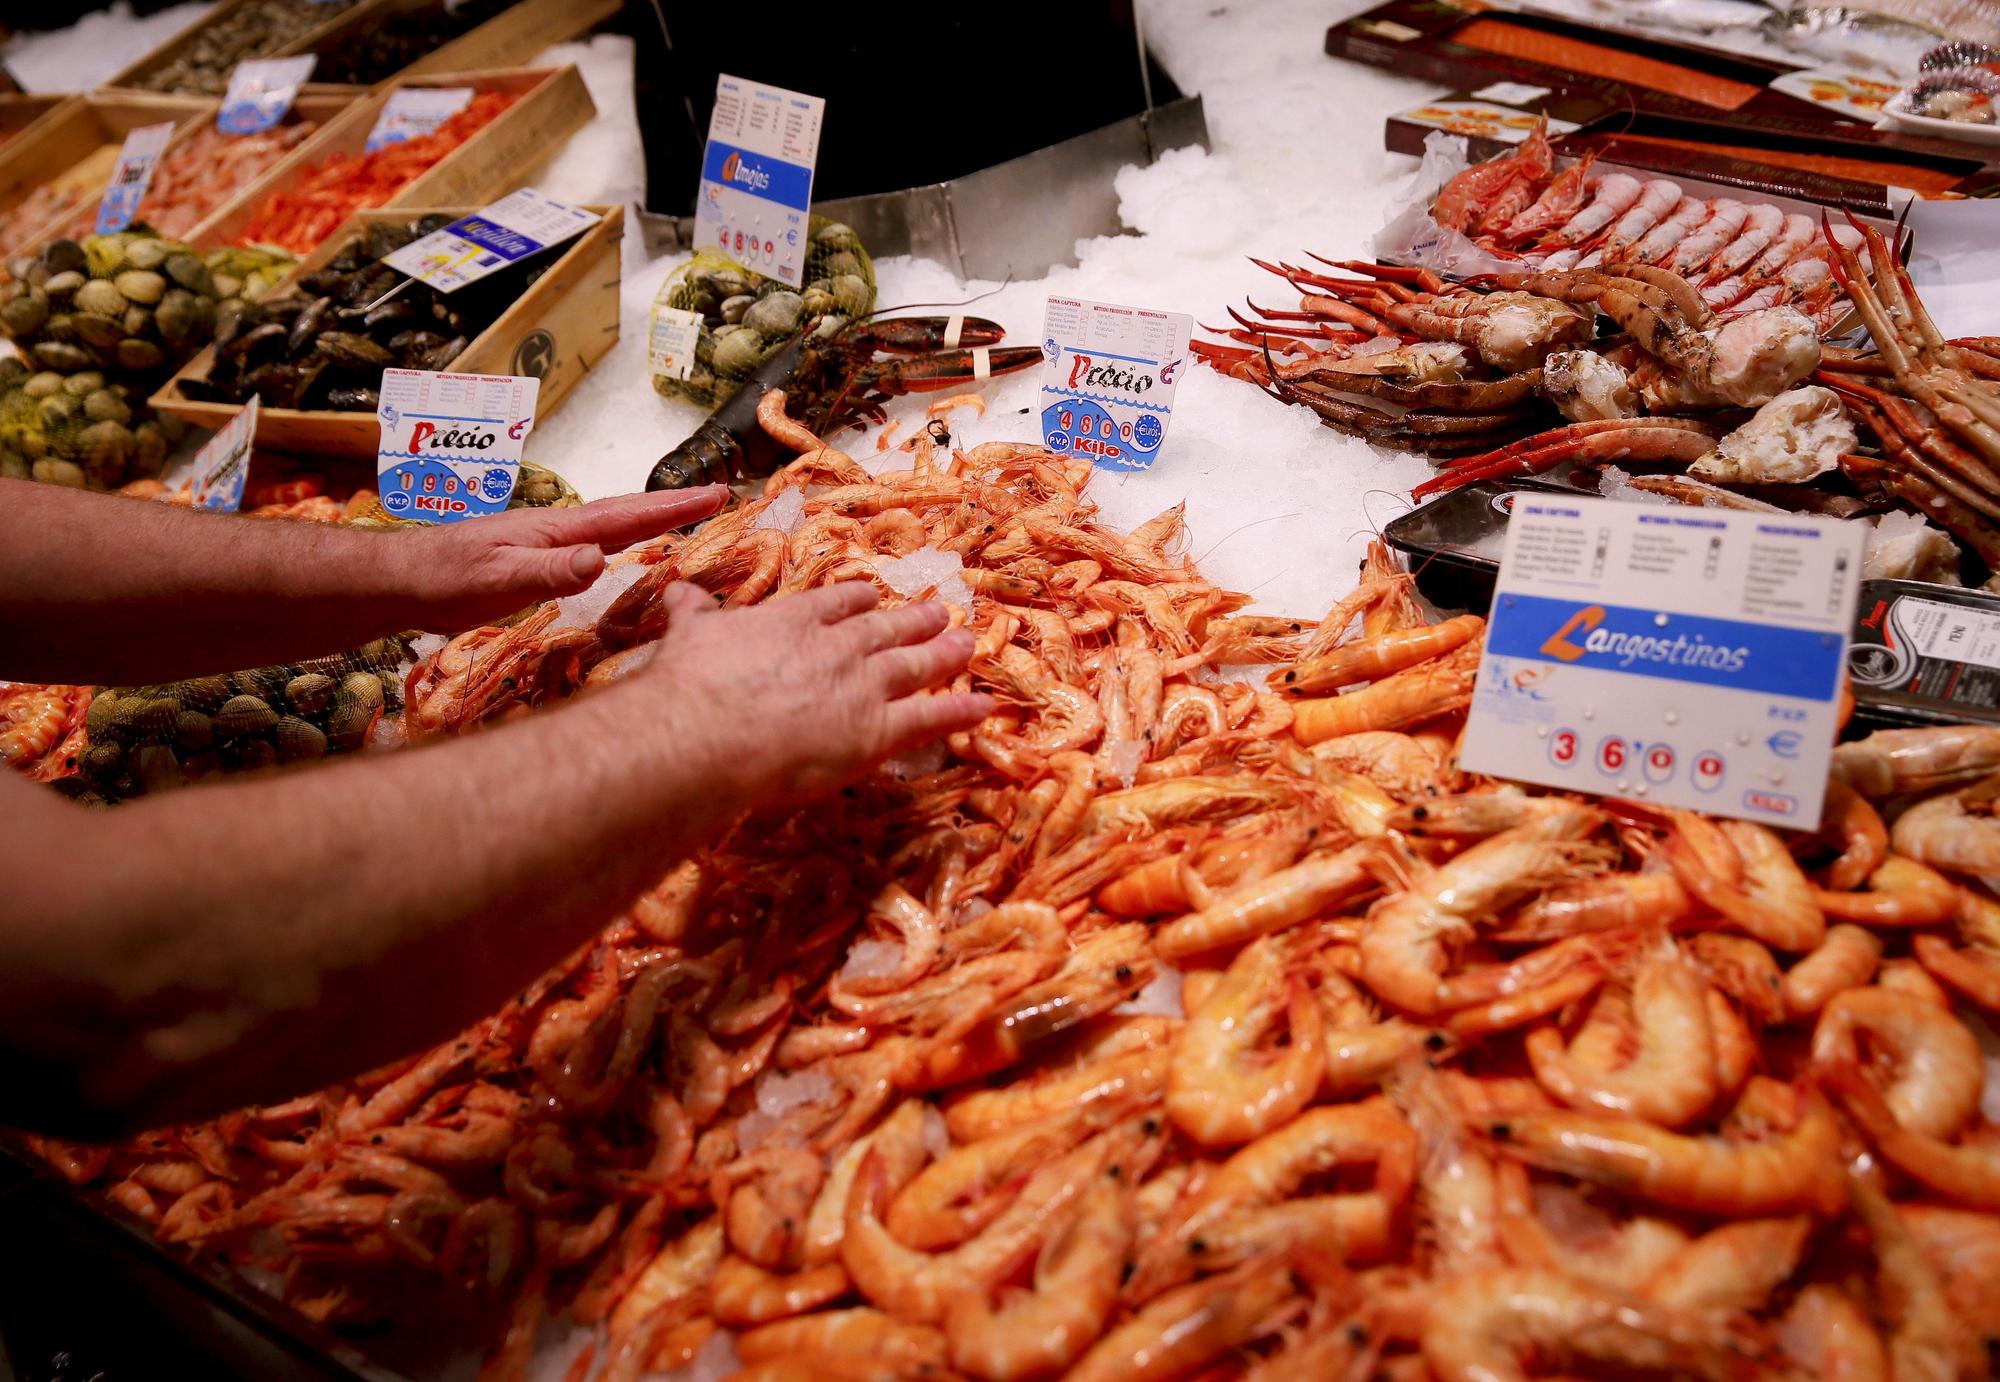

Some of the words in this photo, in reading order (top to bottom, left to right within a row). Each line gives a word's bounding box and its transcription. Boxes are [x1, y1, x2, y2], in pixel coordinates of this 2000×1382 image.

[408, 421, 496, 454] Precio
[1074, 437, 1121, 457] Kilo
[416, 496, 467, 512] Kilo
[1539, 605, 1750, 672] Langostinos
